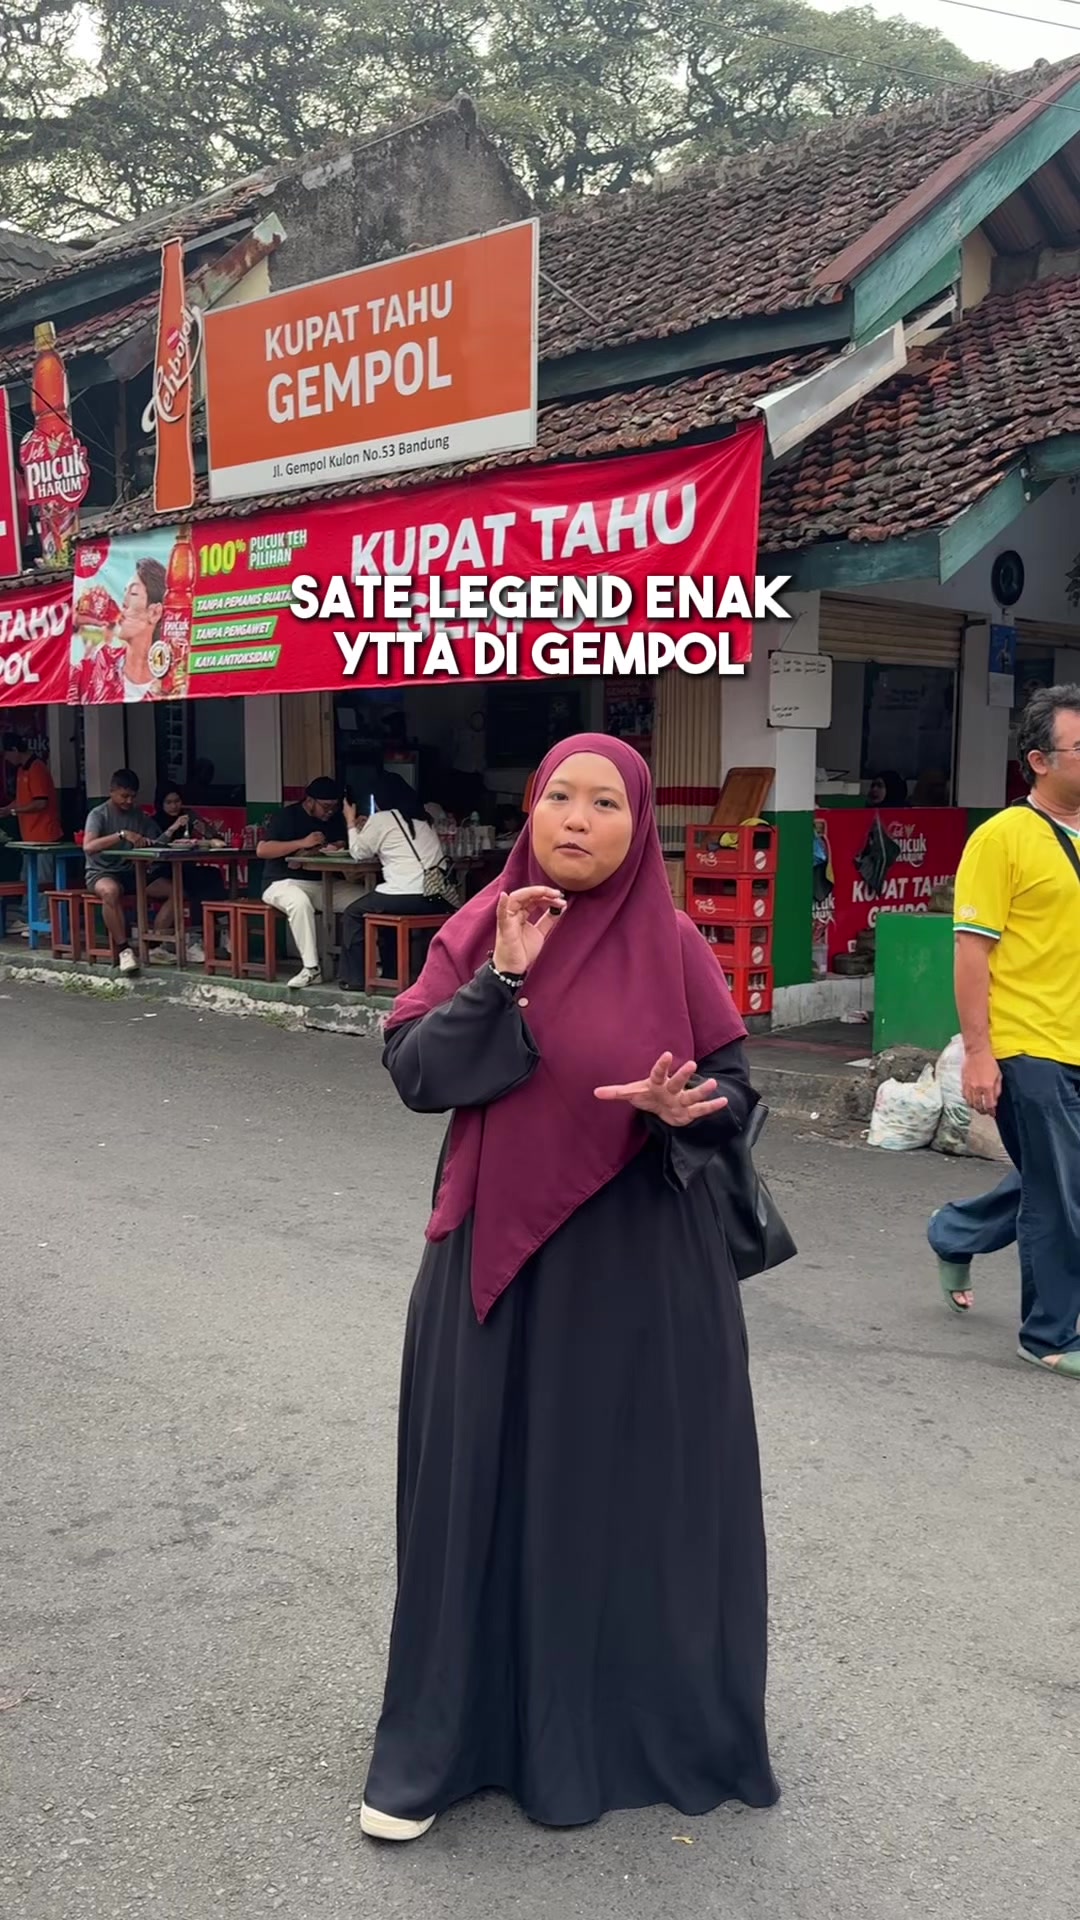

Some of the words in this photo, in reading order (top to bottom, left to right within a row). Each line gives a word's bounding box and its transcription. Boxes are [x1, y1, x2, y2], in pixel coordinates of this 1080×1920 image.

[265, 305, 360, 361] KUPAT
[366, 279, 452, 335] TAHU
[268, 336, 452, 424] GEMPOL
[26, 444, 87, 501] pucuk
[273, 465, 284, 478] Jl.
[286, 456, 326, 477] Gempol
[329, 452, 360, 469] Kulon
[363, 444, 396, 461] No.53
[399, 436, 450, 456] Bandung
[37, 476, 83, 501] HARUM
[250, 535, 286, 550] PUCUK
[287, 529, 308, 547] TEH
[351, 512, 516, 584] KUPAT
[531, 483, 697, 561] TAHU
[200, 539, 246, 576] 100%
[249, 548, 292, 569] PILIHAN
[196, 599, 223, 611] TANPA
[224, 593, 263, 608] PEMANIS
[196, 626, 223, 640] TANPA
[223, 621, 272, 638] PENGAWET
[194, 656, 216, 668] KAYA
[217, 650, 276, 666] ANTIOKSIDAN
